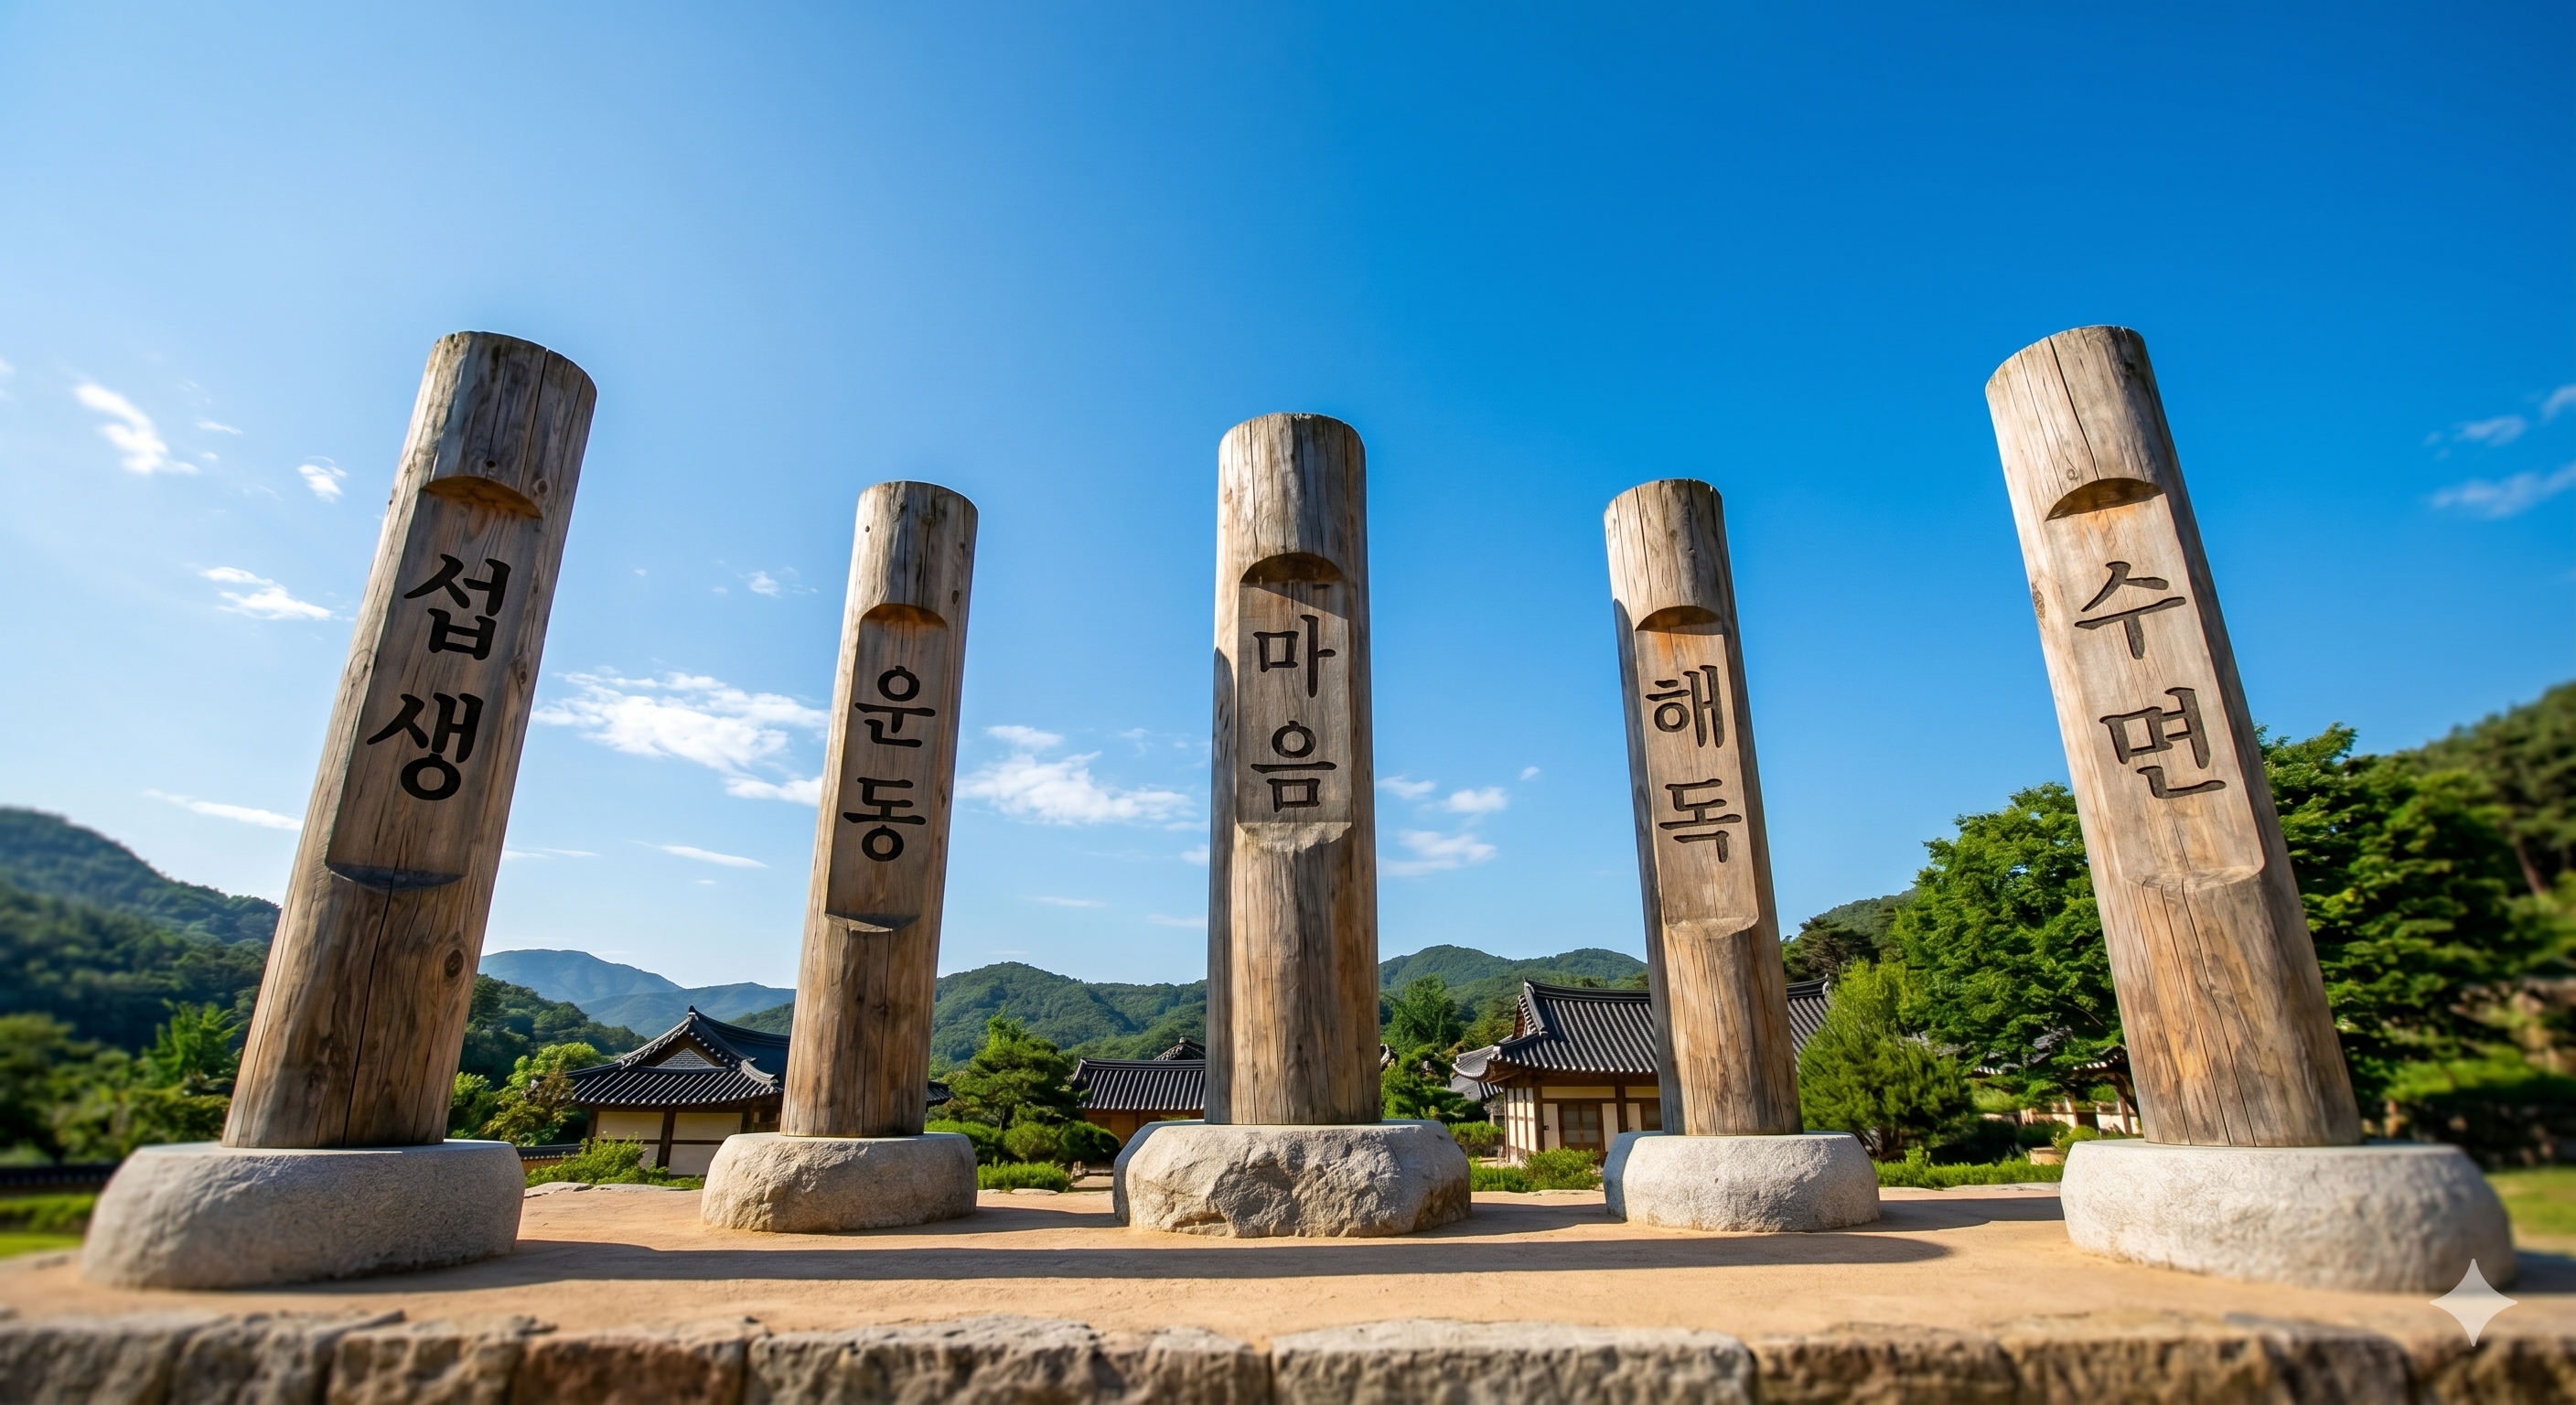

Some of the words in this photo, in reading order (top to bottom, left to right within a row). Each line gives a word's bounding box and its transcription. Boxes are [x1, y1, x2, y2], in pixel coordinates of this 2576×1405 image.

[366, 553, 511, 801] 섭생
[843, 665, 936, 863] 운동
[1250, 614, 1337, 813] 마음
[1645, 664, 1743, 863] 해독
[2074, 561, 2227, 799] 수면
